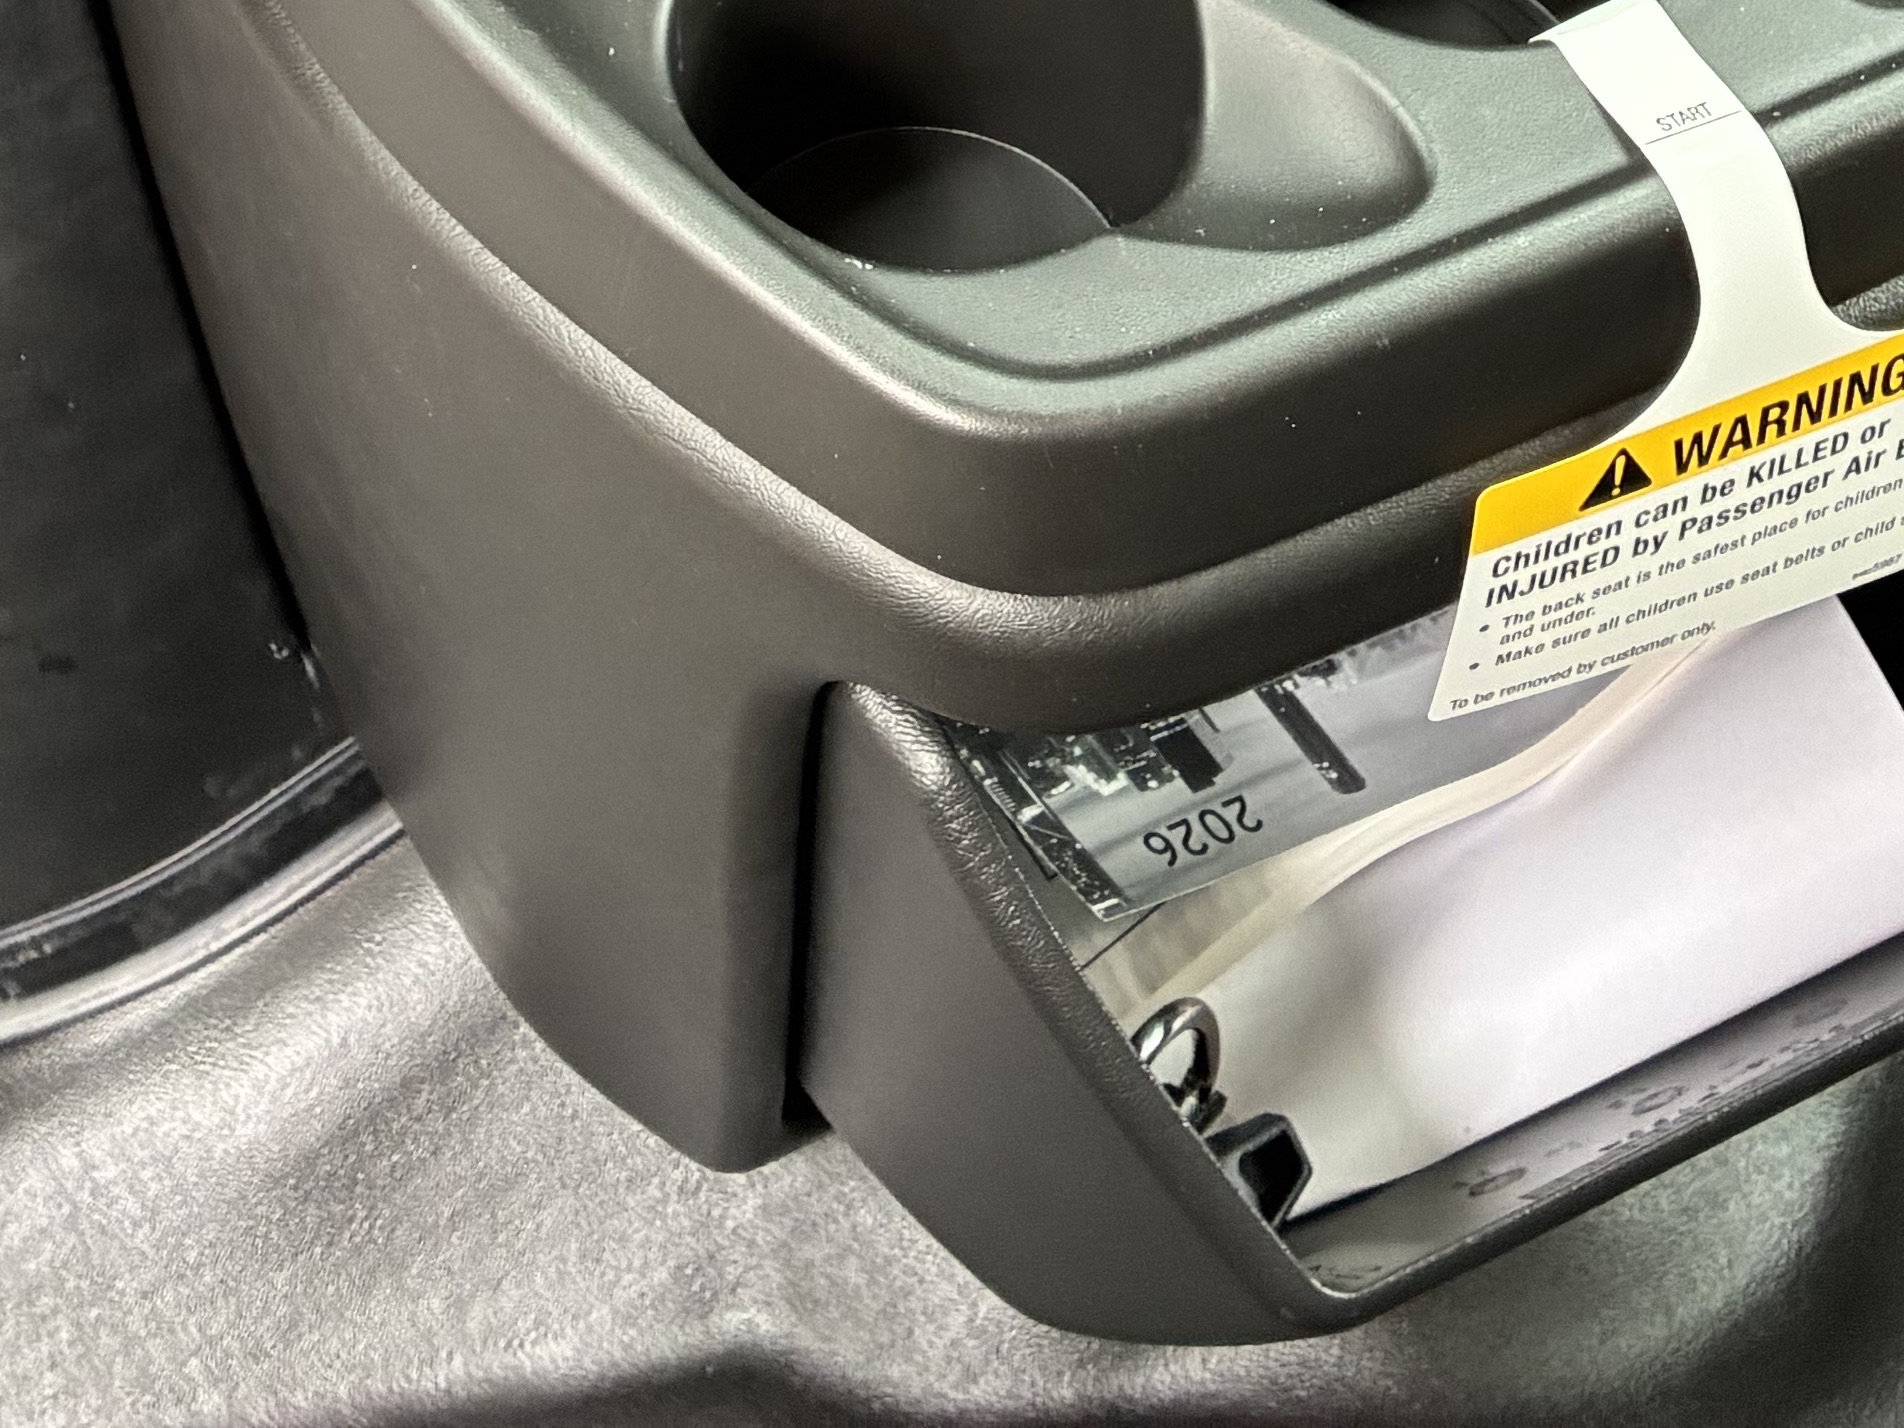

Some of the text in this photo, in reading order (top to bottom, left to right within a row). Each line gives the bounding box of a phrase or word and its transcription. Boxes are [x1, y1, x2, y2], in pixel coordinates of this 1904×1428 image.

[1655, 100, 1713, 133] START
[1484, 544, 1621, 609] INJURED
[1631, 530, 1669, 559] by
[1677, 466, 1836, 542] Passenger
[1842, 447, 1887, 482] Air
[1491, 416, 1892, 579] Children can be KILLED or
[1501, 607, 1536, 629] The
[1541, 591, 1587, 617] back
[1591, 575, 1632, 600] seat
[1636, 569, 1652, 586] is
[1658, 556, 1686, 578] the
[1692, 535, 1747, 567] safest
[1751, 514, 1800, 546] place
[1804, 503, 1831, 525] for
[1834, 477, 1904, 514] children
[1495, 643, 1546, 667] Make
[1551, 626, 1592, 650] sure
[1597, 615, 1620, 635] all
[1625, 591, 1698, 626] children
[1704, 578, 1735, 598] use
[1740, 560, 1779, 584] seat
[1782, 545, 1826, 570] belts
[1830, 535, 1851, 554] or
[1853, 516, 1897, 544] child
[1499, 606, 1597, 646] and under.
[1449, 619, 1717, 712] To be removed by customer only.
[1142, 793, 1264, 869] 2026
